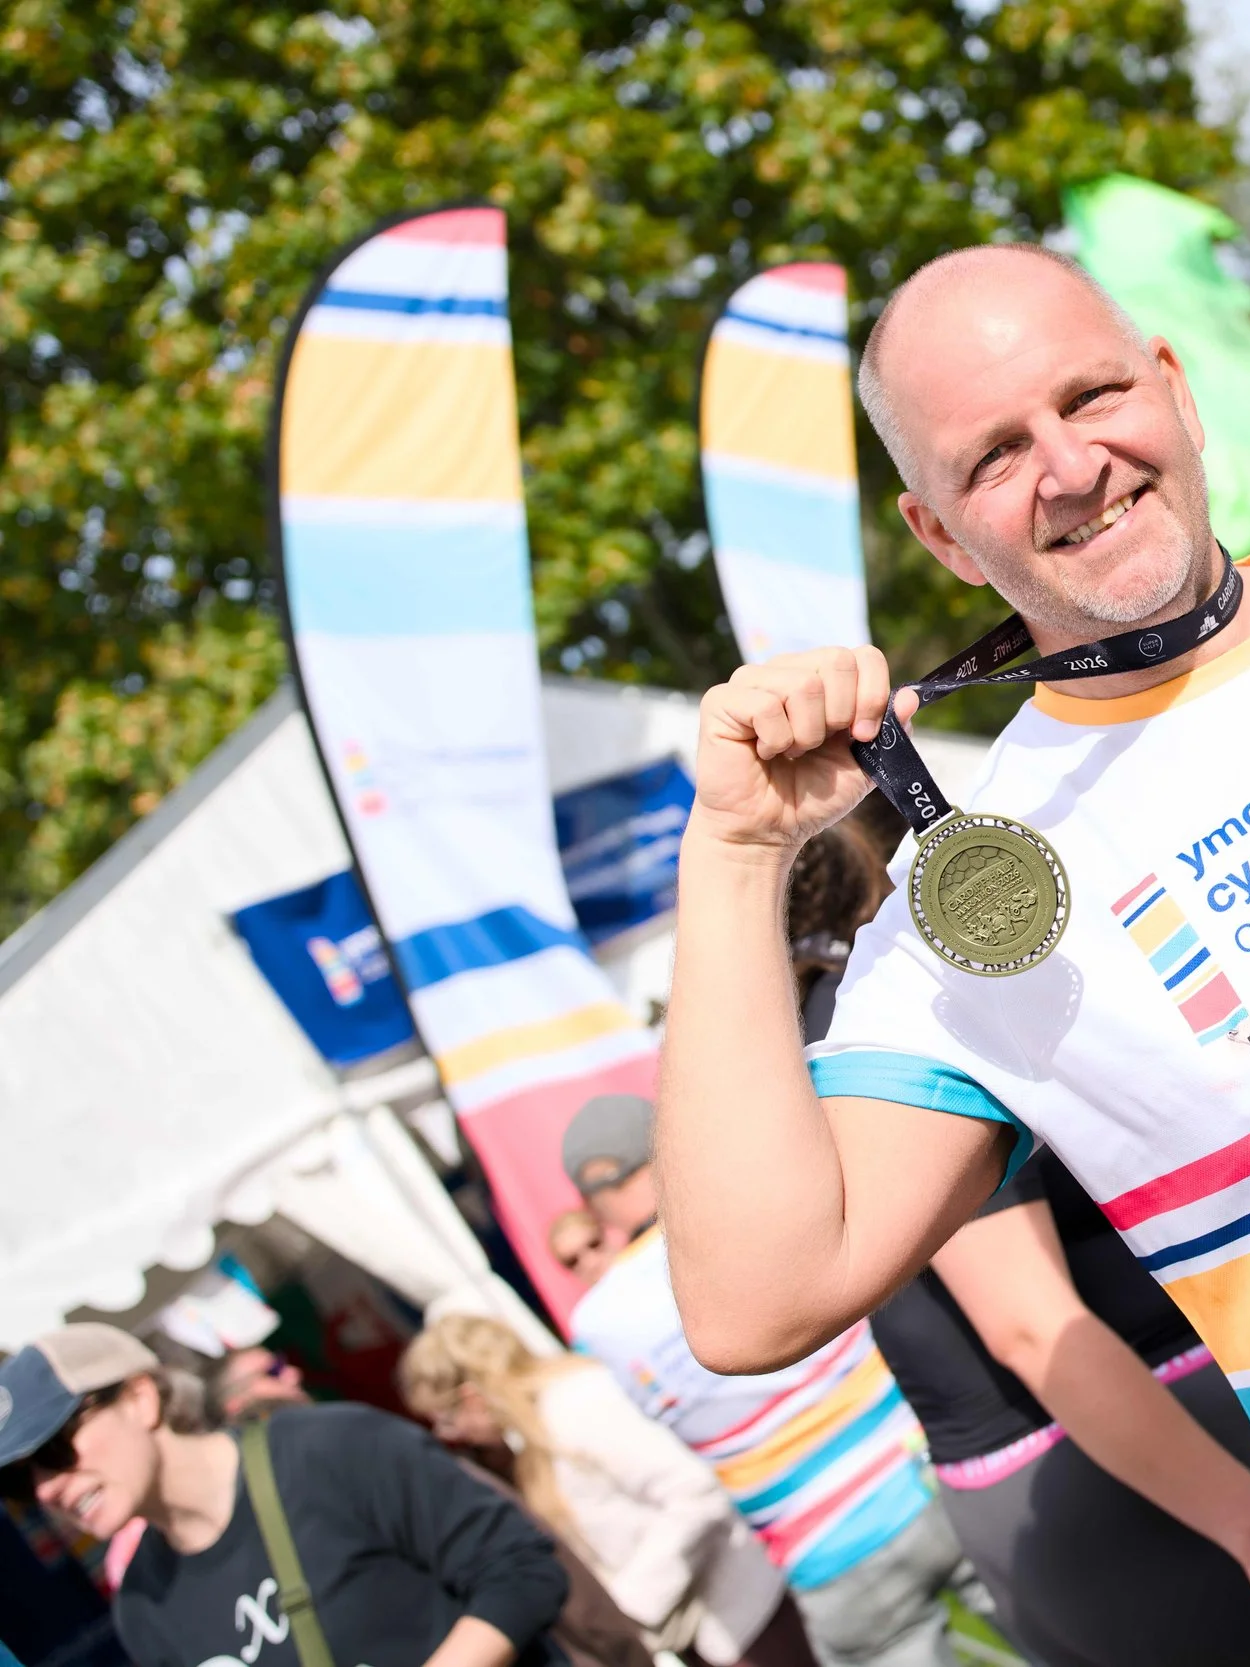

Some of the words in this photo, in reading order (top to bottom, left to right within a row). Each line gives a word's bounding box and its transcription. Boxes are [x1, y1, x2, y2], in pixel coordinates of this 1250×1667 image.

[955, 656, 979, 682] 2026
[1064, 654, 1109, 672] 2026
[907, 781, 939, 826] 026
